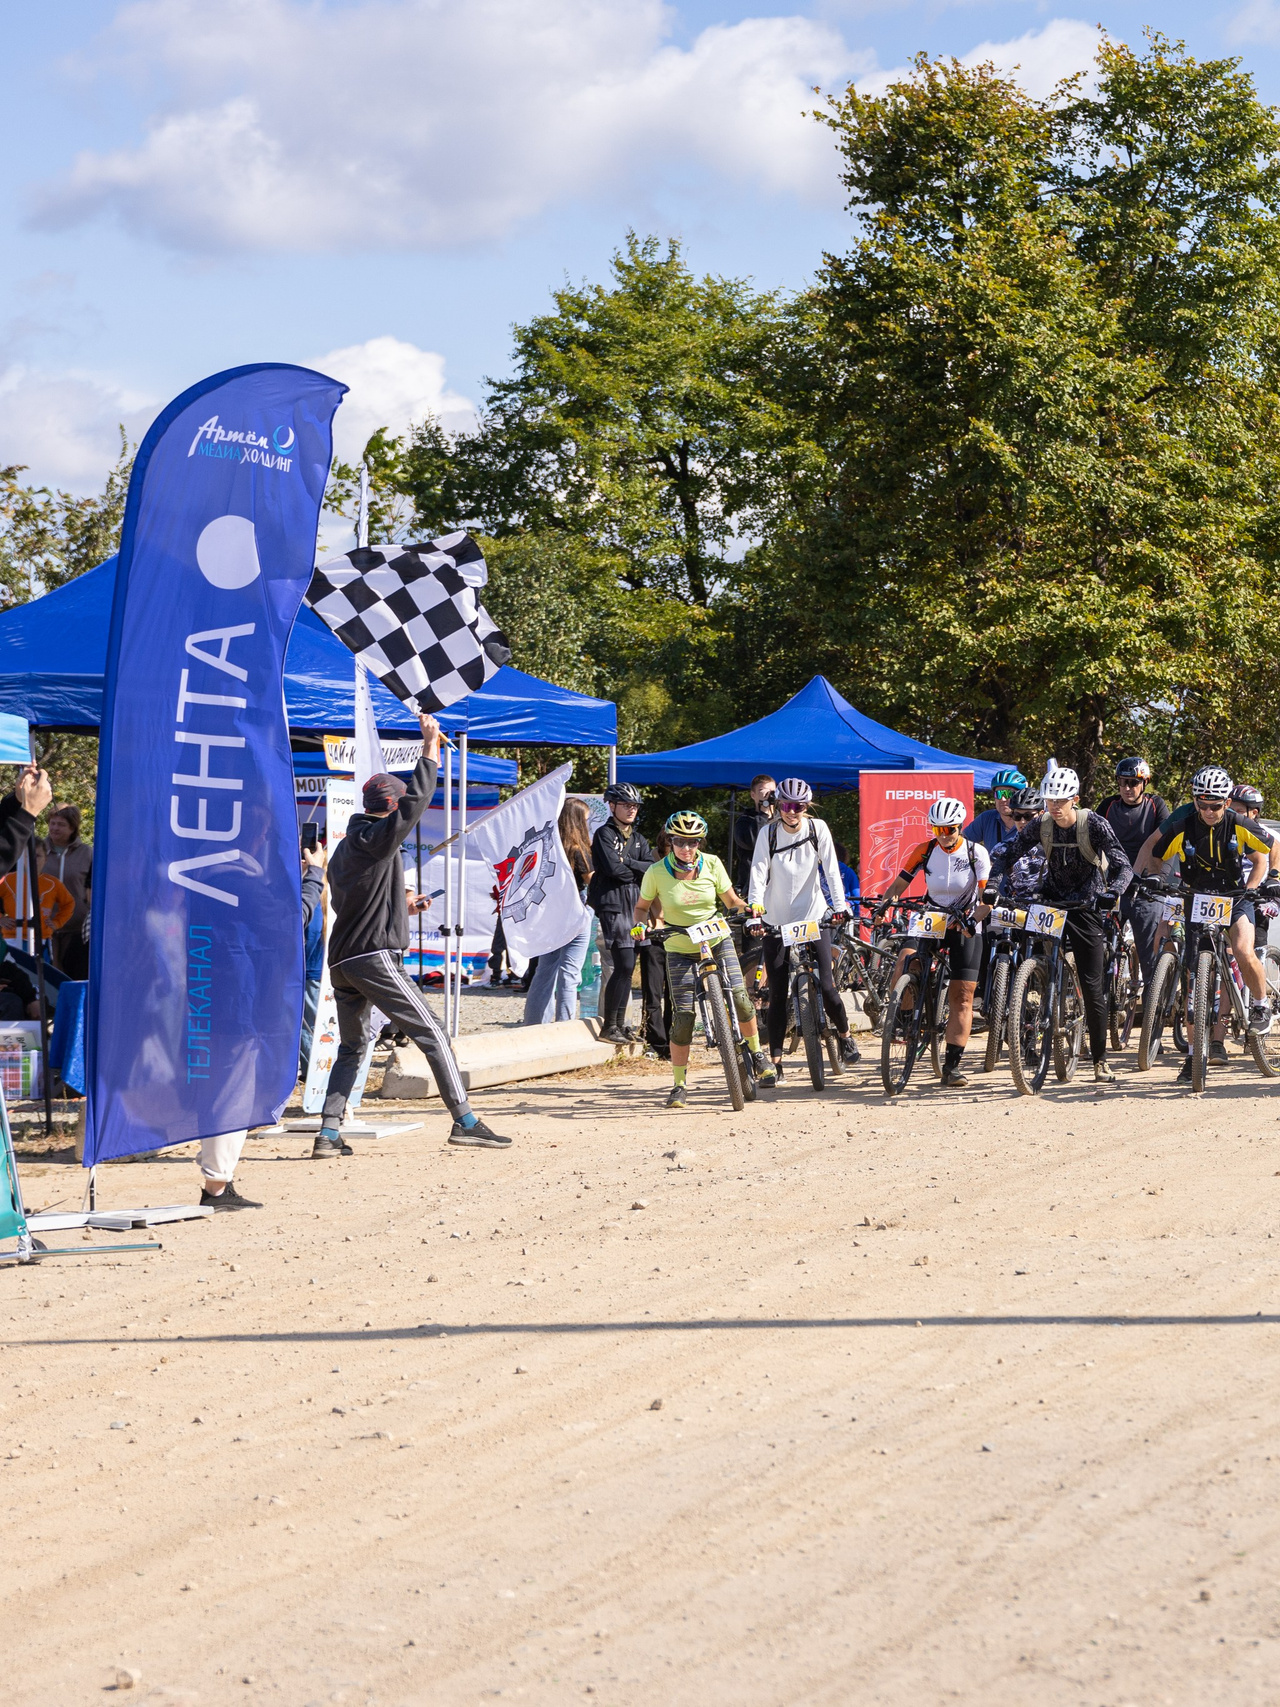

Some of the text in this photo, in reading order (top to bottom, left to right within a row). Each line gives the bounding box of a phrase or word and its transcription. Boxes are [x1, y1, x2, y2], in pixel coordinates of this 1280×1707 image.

[187, 415, 269, 458] Артём
[168, 622, 256, 907] ЛЕНТА
[885, 790, 946, 800] ПЕРВЫЕ
[1001, 909, 1016, 923] 80
[1200, 901, 1224, 918] 561
[1038, 911, 1054, 928] 90
[696, 922, 721, 936] 111
[792, 924, 808, 938] 97
[187, 924, 212, 1085] ТЕЛЕКАНАЛ
